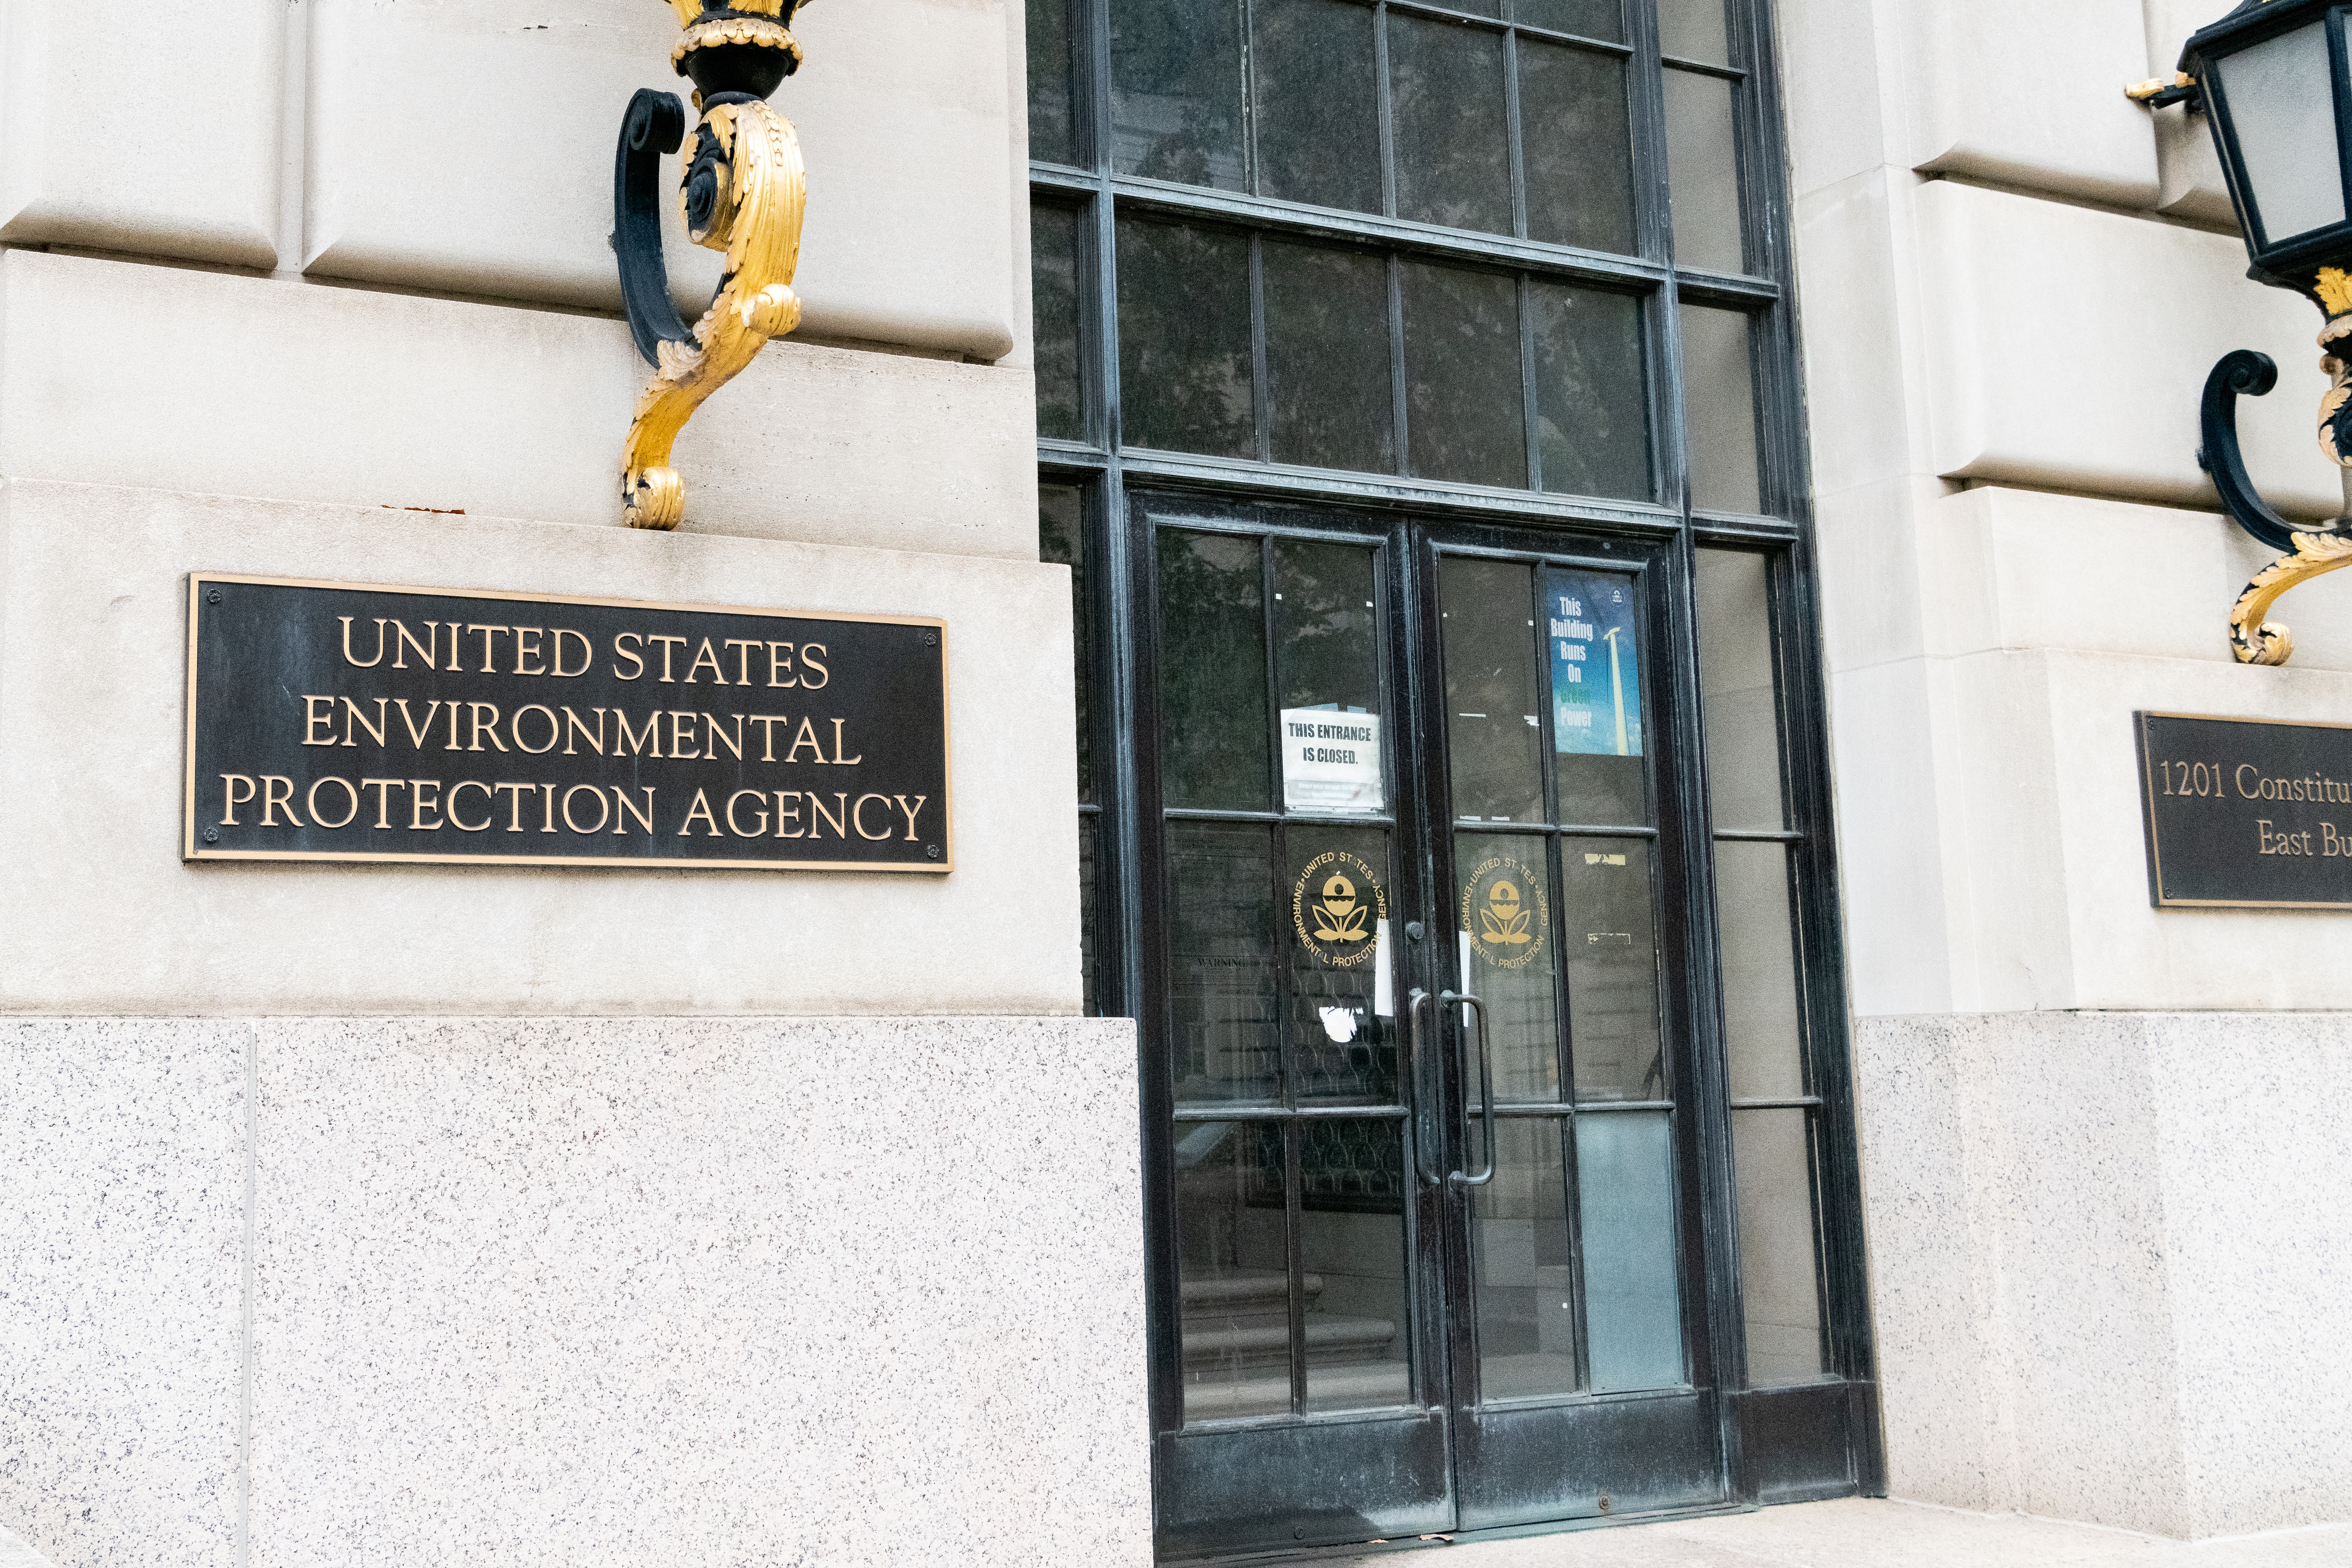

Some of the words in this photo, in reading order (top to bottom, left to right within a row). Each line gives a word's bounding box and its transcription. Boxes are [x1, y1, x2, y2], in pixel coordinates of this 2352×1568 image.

[1559, 596, 1581, 617] This
[1551, 618, 1593, 642] Building
[337, 616, 592, 677] UNITED
[613, 632, 828, 689] STATES
[1560, 641, 1586, 661] Runs
[1568, 663, 1581, 683] On
[301, 694, 862, 764] ENVIRONMENTAL
[1560, 706, 1592, 727] Power
[1288, 723, 1315, 738] THIS
[1318, 724, 1371, 742] ENTRANCE
[1303, 747, 1315, 762] IS
[1317, 748, 1359, 764] CLOSED.
[2161, 760, 2225, 797] 1201
[2235, 764, 2352, 803] Constitu
[219, 773, 656, 835] PROTECTION
[677, 788, 927, 841] AGENCY
[2257, 819, 2313, 856] East
[2320, 822, 2352, 857] Bu
[1302, 852, 1335, 879] UNITED
[1339, 852, 1373, 880] STTES
[1470, 858, 1501, 883] UNITED
[1504, 858, 1536, 885] STTES
[1293, 881, 1329, 963] ENVIRONMENTL
[1332, 931, 1383, 967] PROTECTION
[1462, 885, 1495, 965] ENVIRONMENTL
[1498, 935, 1544, 969] PROTECTION
[1198, 958, 1246, 967] WARNING
